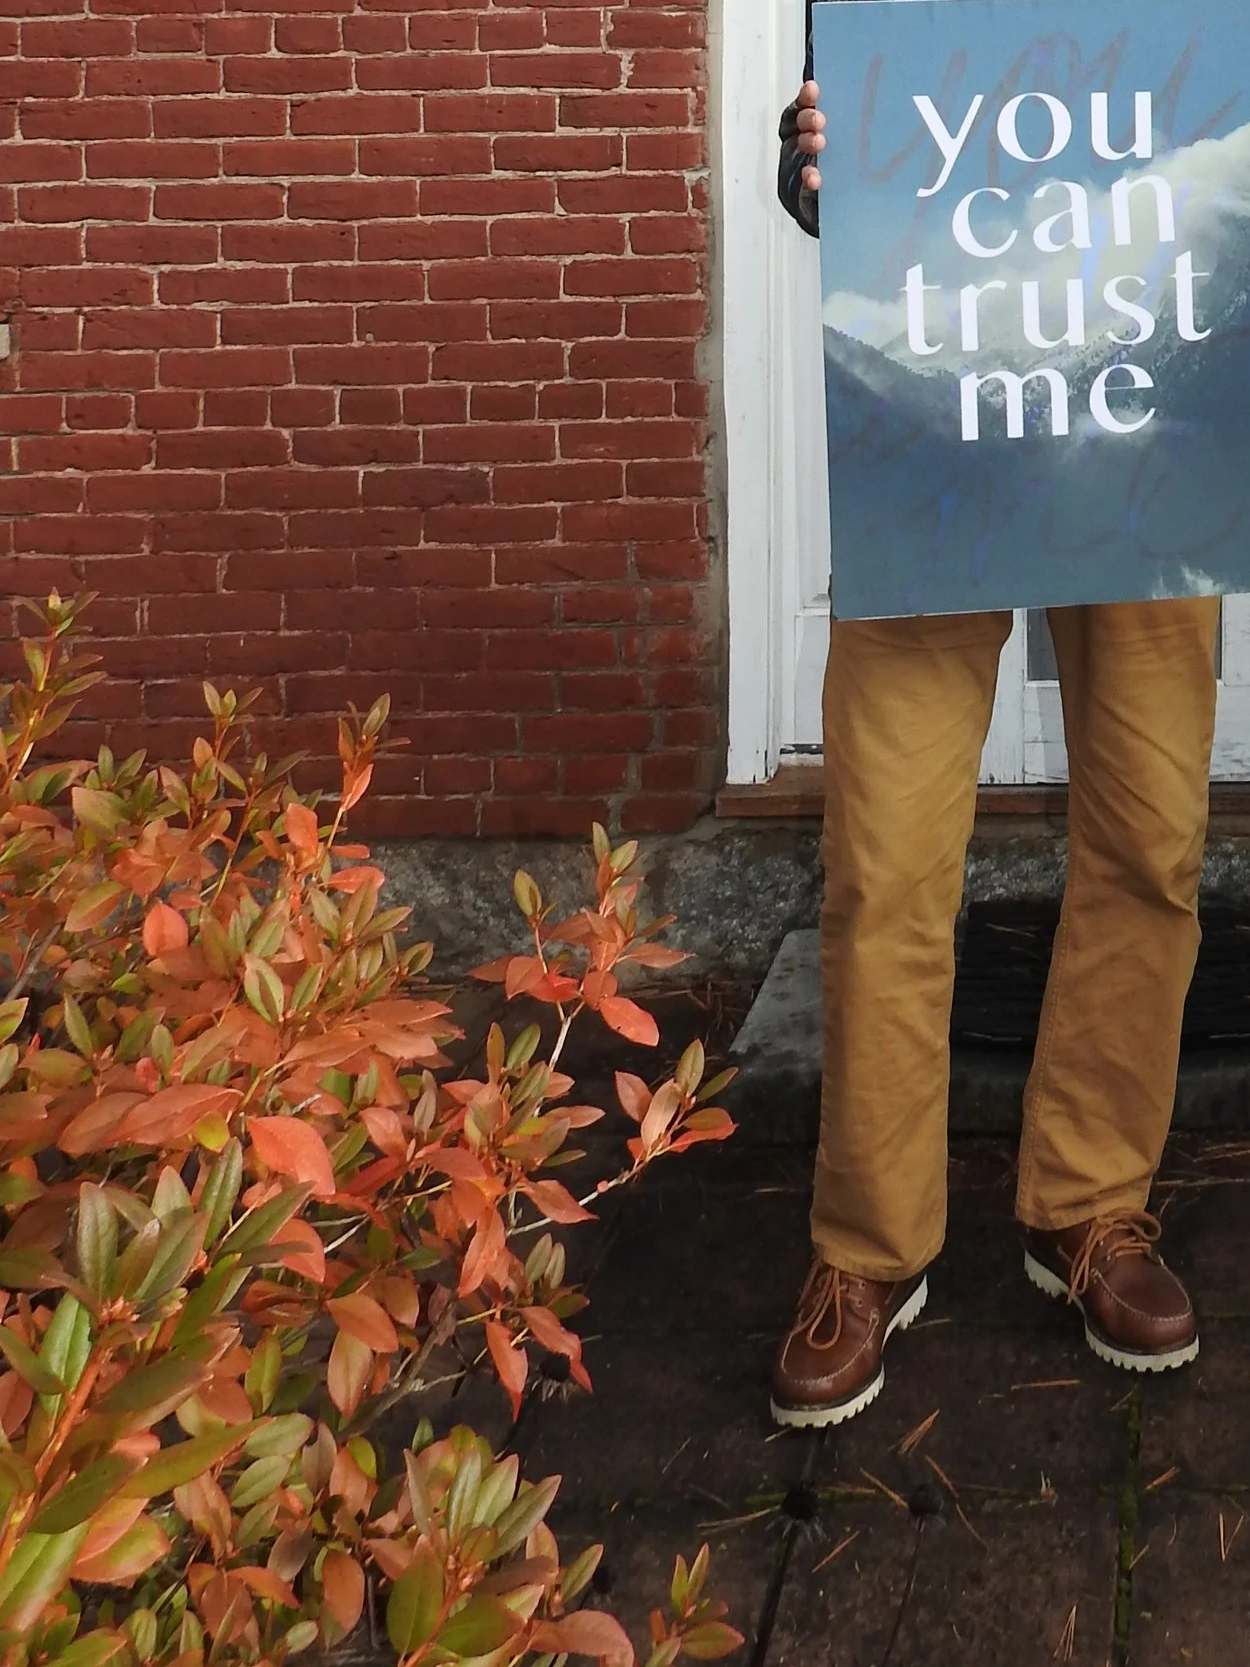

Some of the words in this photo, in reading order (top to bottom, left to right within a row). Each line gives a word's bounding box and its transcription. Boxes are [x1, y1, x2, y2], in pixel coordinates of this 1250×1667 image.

[912, 91, 1153, 198] you
[951, 173, 1176, 258] can
[900, 250, 1212, 356] trust
[959, 363, 1156, 442] me
